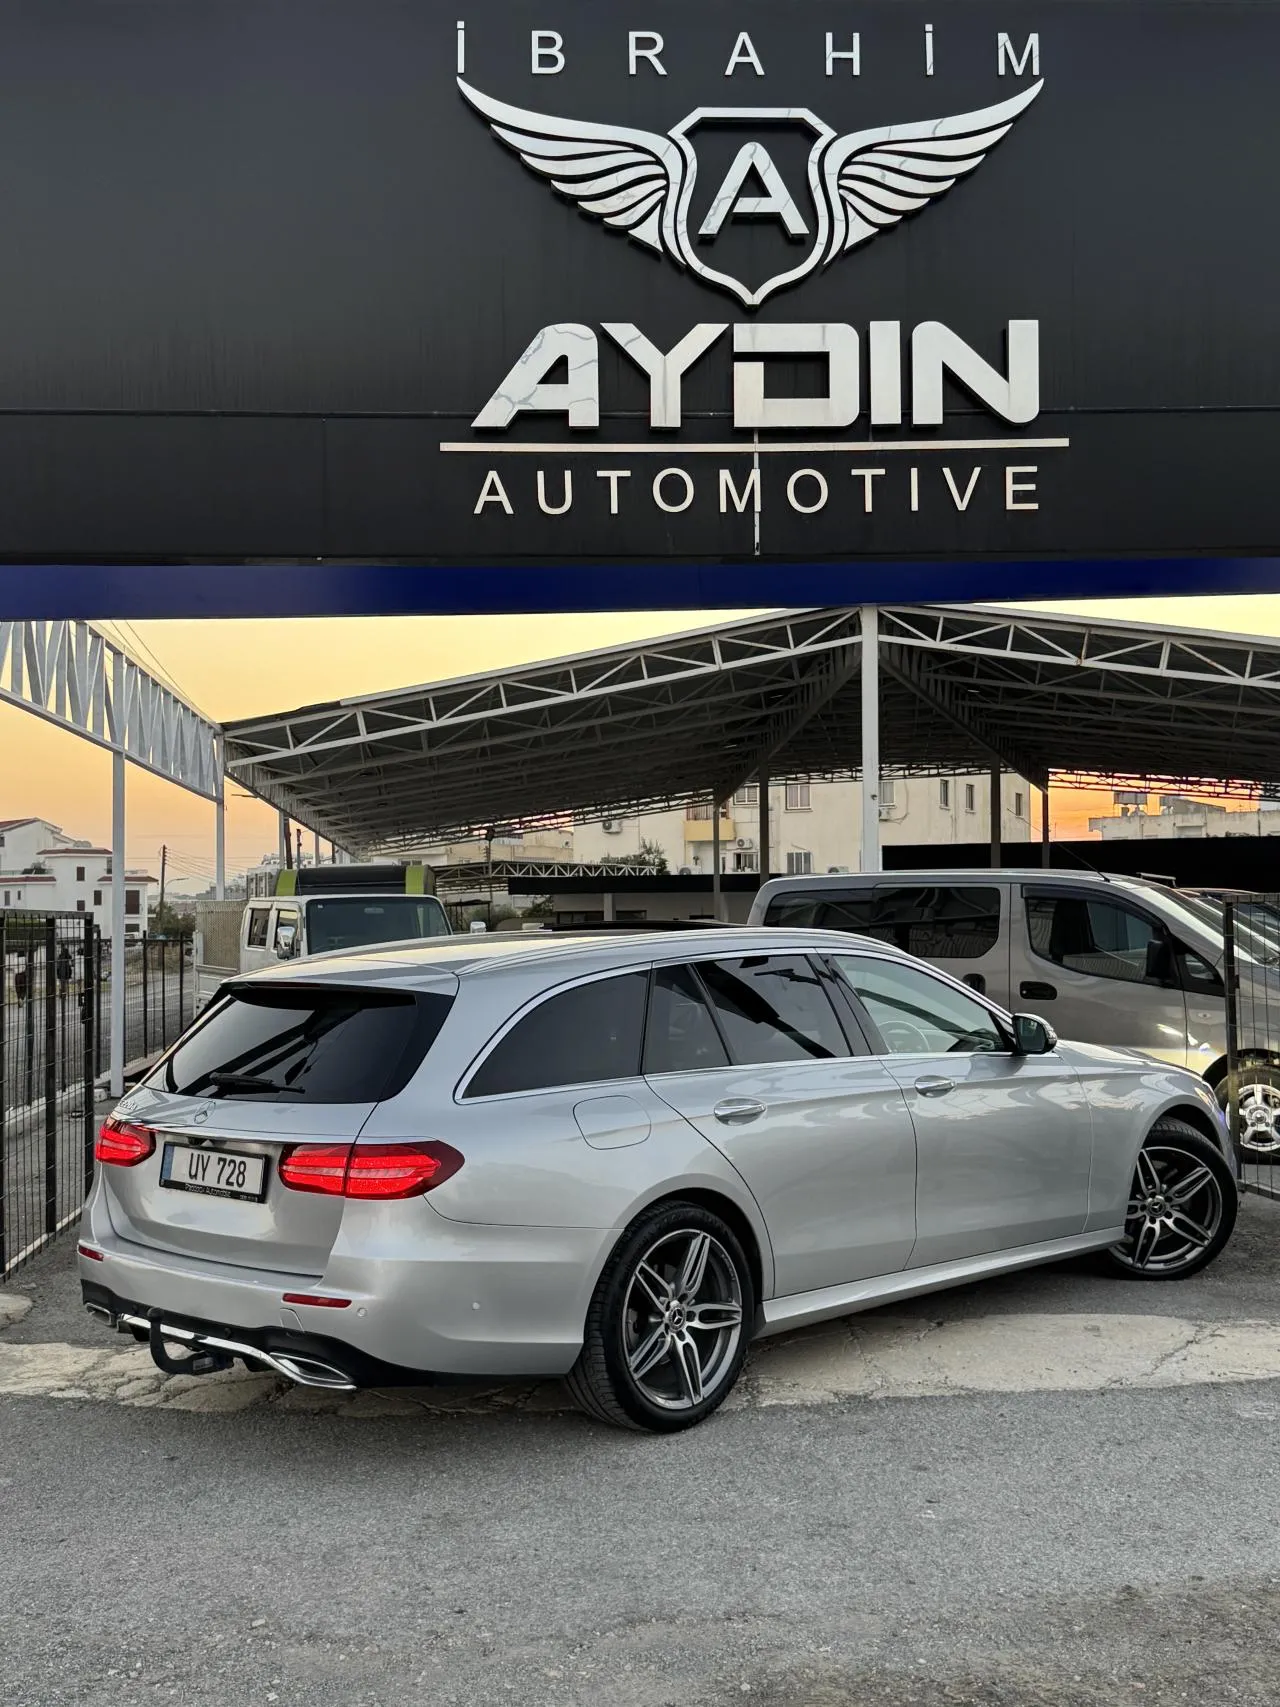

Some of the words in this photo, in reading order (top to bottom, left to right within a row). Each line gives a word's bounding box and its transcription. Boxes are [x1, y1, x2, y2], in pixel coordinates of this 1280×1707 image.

[456, 21, 1040, 77] İBRAHİM
[697, 141, 810, 237] A
[471, 319, 1040, 428] AYDIN
[474, 464, 1040, 515] AUTOMOTIVE
[188, 1152, 211, 1181] UY
[217, 1157, 247, 1188] 728
